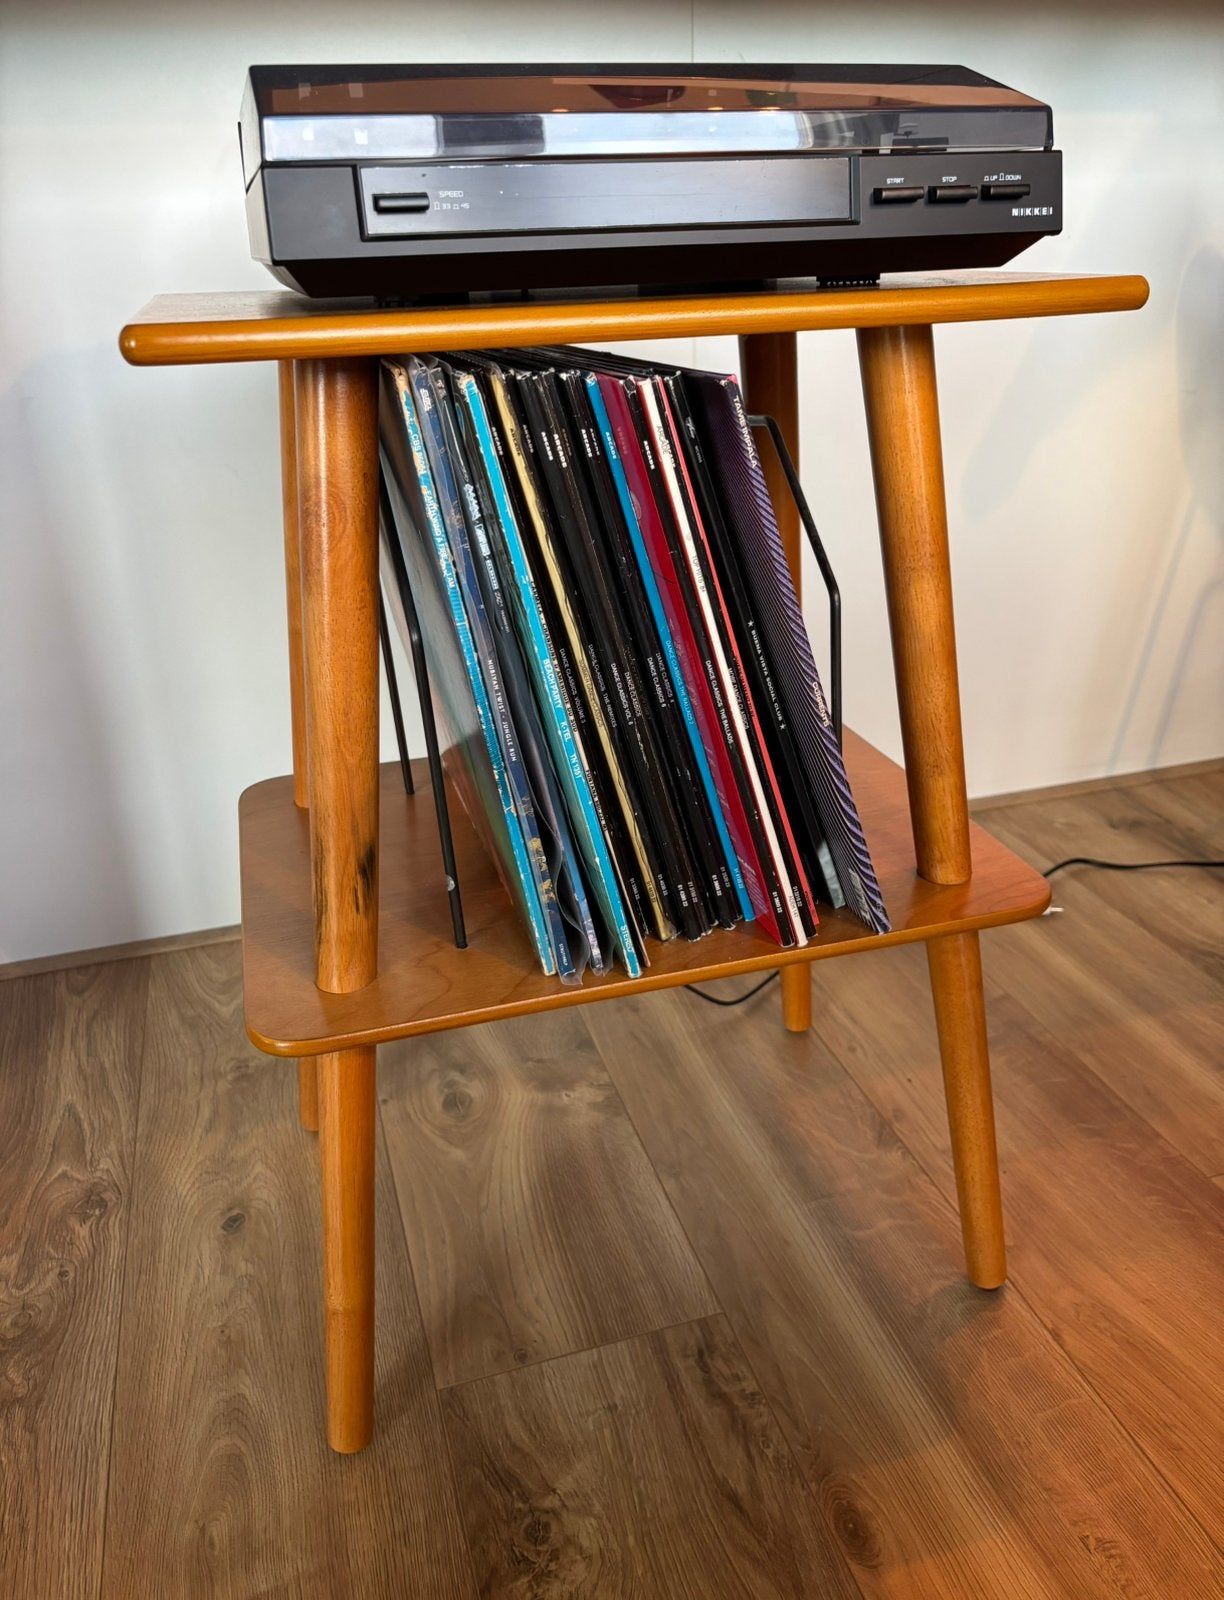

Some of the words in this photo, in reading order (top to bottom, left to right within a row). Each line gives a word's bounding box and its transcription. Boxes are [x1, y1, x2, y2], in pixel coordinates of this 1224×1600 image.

[439, 190, 464, 198] SPEED
[1012, 206, 1053, 217] NIKKEI
[411, 433, 420, 450] CBS
[490, 426, 503, 456] ARCADE
[541, 432, 554, 461] ARCADE
[580, 428, 592, 458] ARCADE
[604, 430, 617, 459] ARCADE
[732, 394, 746, 427] TAME
[741, 426, 757, 468] IMPALA
[552, 432, 567, 468] ARCADE
[642, 440, 655, 469] ARCADE
[447, 576, 455, 588] AM
[558, 648, 569, 668] DANCE
[564, 668, 577, 695] CLASSICS
[573, 696, 584, 718] VOLUME
[610, 662, 620, 682] DANCE
[615, 682, 628, 708] CLASSICS
[646, 656, 656, 676] DANCE
[652, 676, 664, 703] CLASSICS
[655, 652, 665, 671] DANCE
[660, 671, 673, 697] CLASSICS
[665, 640, 675, 659] DANCE
[670, 658, 683, 686] CLASSICS
[678, 685, 686, 696] THE
[682, 697, 692, 721] BALLADS
[704, 659, 715, 680] DANCE
[750, 629, 761, 654] BUENA
[758, 655, 768, 676] VISTA
[765, 676, 776, 702] SOCIAL
[773, 702, 782, 721] CLUB
[542, 658, 556, 687] BEACH
[550, 685, 562, 708] PARTY
[559, 721, 571, 742] K-TEL
[593, 663, 606, 691] CLASSICS
[602, 692, 610, 704] THE
[606, 704, 617, 728] REMIXES
[623, 671, 634, 690] DANCE
[629, 690, 641, 717] CLASSICS
[710, 679, 723, 707] CLASSICS
[727, 667, 736, 683] MORE
[732, 683, 742, 703] DANCE
[737, 702, 749, 729] CLASSICS
[811, 680, 830, 727] CURRENTS
[486, 659, 498, 690] NUBIYAN
[494, 692, 505, 713] TWIST
[502, 720, 512, 746] JUNGLE
[508, 747, 516, 762] RUN
[570, 718, 578, 732] SUD
[719, 708, 727, 719] THE
[722, 719, 734, 744] BALLADS
